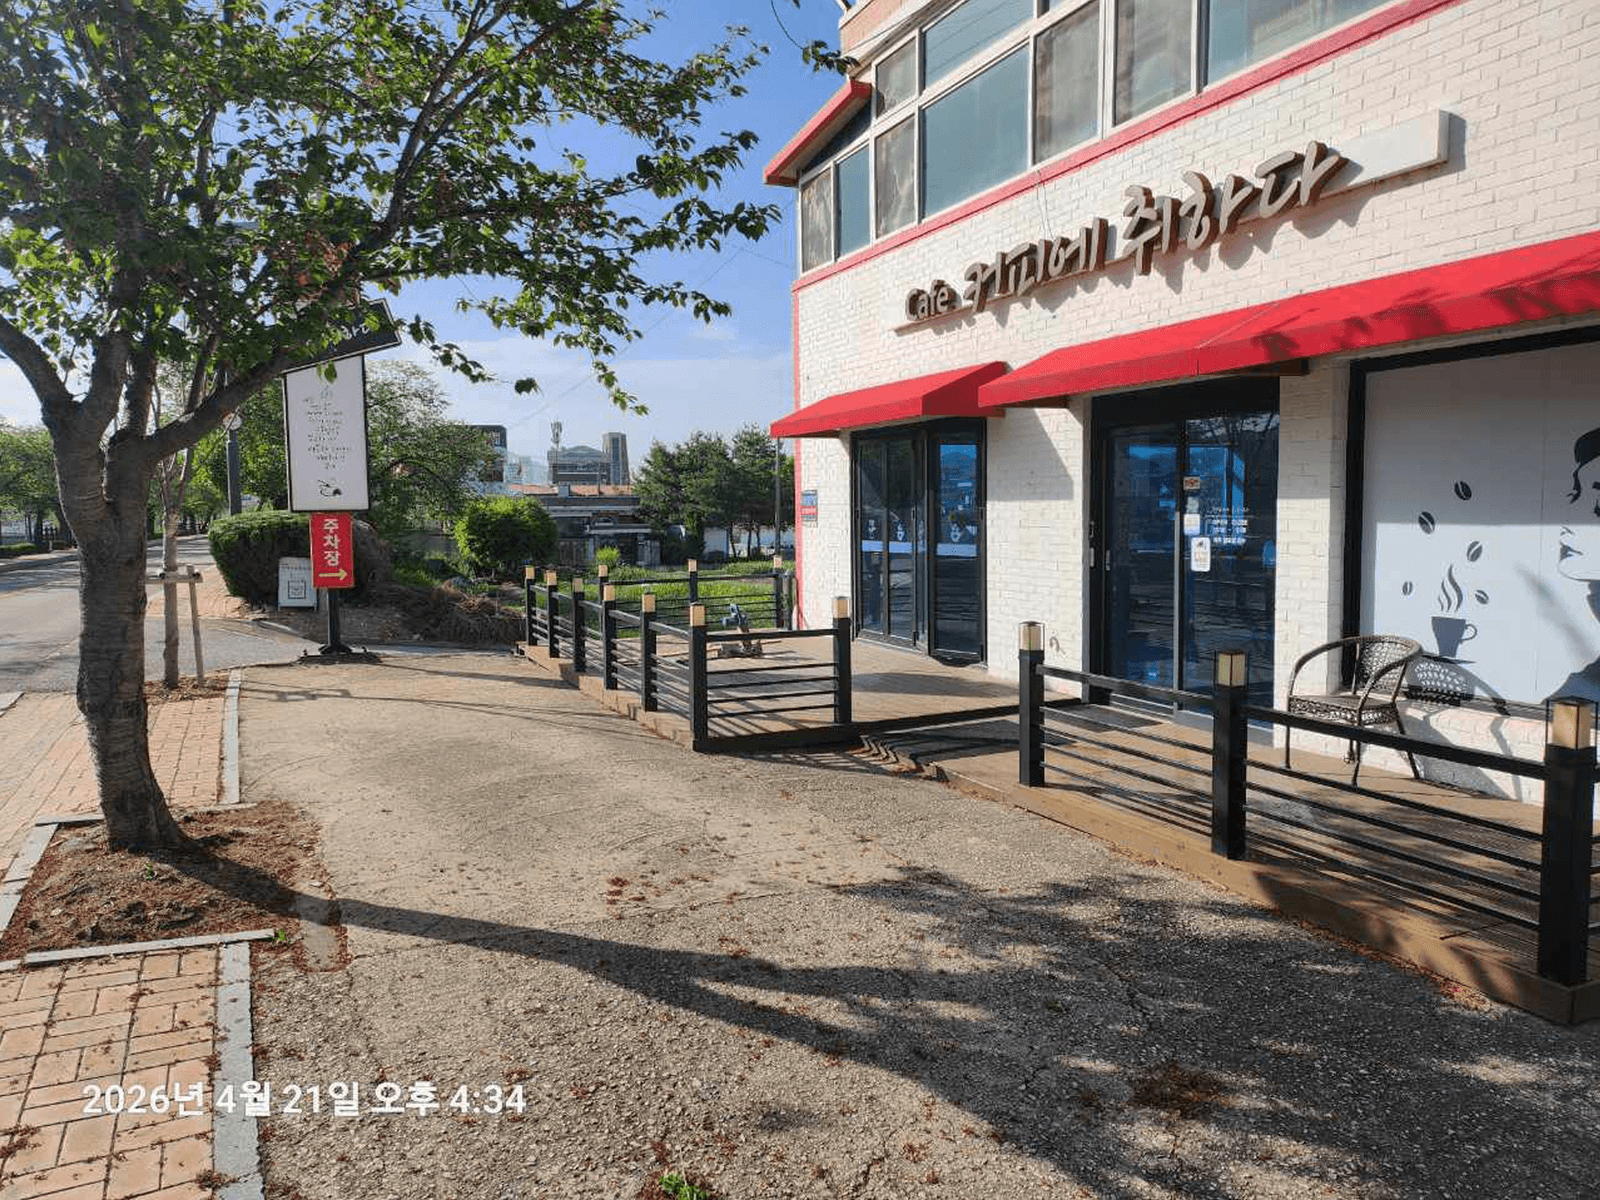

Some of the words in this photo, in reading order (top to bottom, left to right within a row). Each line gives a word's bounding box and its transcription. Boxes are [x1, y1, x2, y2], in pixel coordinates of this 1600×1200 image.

[962, 217, 1107, 312] 커피에
[1122, 140, 1350, 275] 취하다
[322, 518, 341, 567] 주차장
